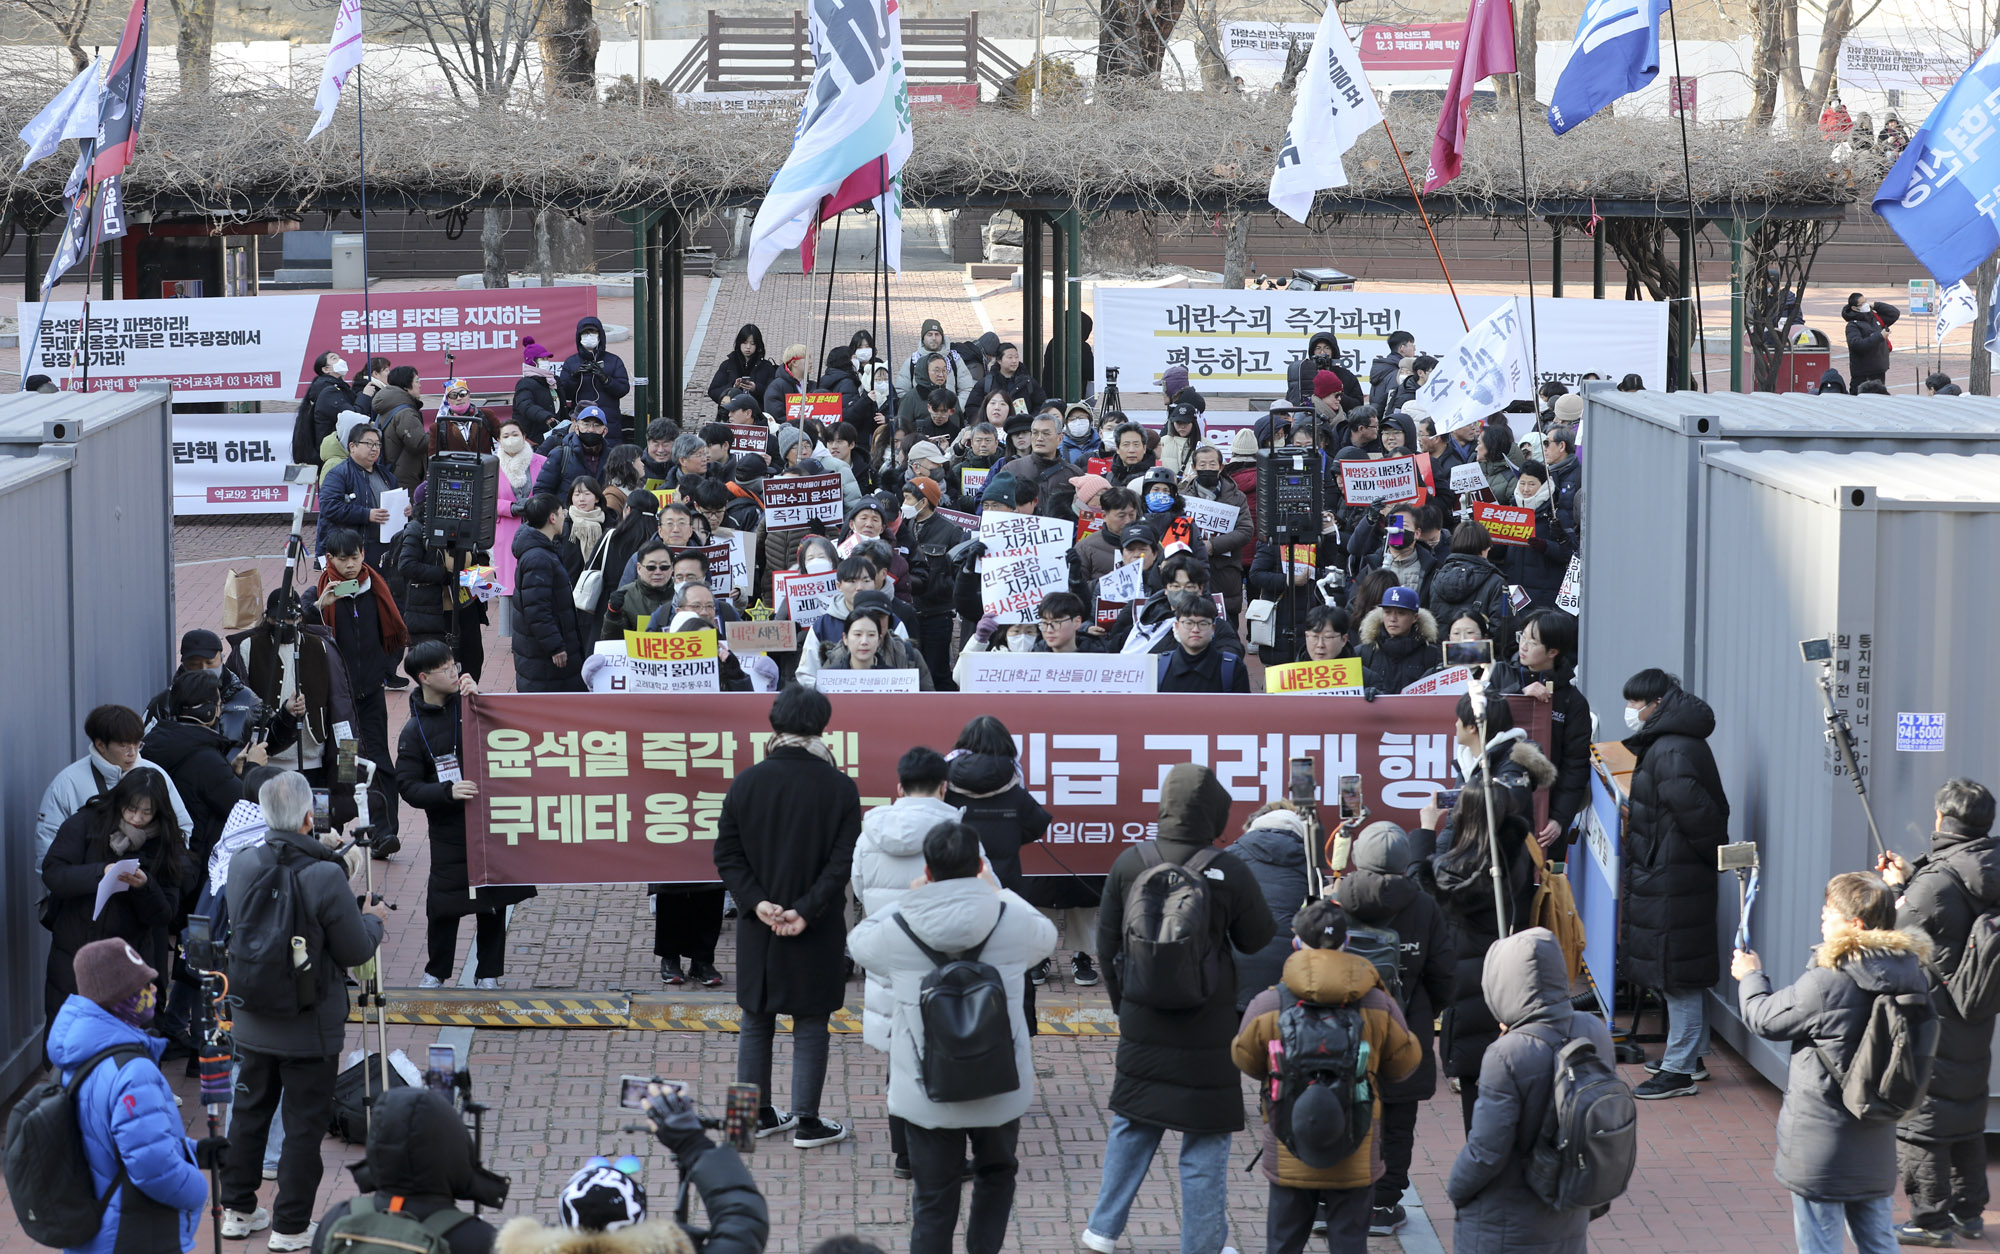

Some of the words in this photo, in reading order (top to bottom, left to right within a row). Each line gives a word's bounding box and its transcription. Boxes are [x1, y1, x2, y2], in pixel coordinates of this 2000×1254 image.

[1231, 38, 1256, 49] 반민주
[1269, 28, 1317, 40] 민주광장에
[1376, 40, 1394, 51] 12.3
[40, 319, 83, 335] 윤석열
[88, 318, 119, 334] 즉각
[123, 316, 189, 331] 파면하라!
[340, 308, 397, 330] 윤석열
[402, 307, 460, 328] 퇴진을
[464, 305, 541, 326] 지지하는
[1165, 304, 1272, 335] 내란수괴
[1284, 307, 1402, 337] 즉각파면!
[40, 335, 86, 352] 쿠데타
[89, 333, 164, 351] 옹호자들은
[169, 330, 262, 349] 민주광장에서
[340, 332, 417, 354] 후배들을
[422, 329, 518, 352] 응원합니다
[41, 352, 72, 368] 당장
[75, 351, 126, 368] 나가라!
[92, 379, 125, 392] 사범대
[227, 376, 240, 387] 03
[243, 375, 274, 387] 나지현
[172, 441, 218, 464] 탄핵
[224, 440, 276, 463] 하라.
[739, 439, 766, 450] 윤석열
[1378, 462, 1413, 477] 내란동조
[766, 492, 808, 506] 내란수괴
[811, 487, 841, 502] 윤석열
[773, 508, 801, 523] 즉각
[805, 504, 838, 520] 파면!
[1481, 507, 1528, 523] 윤석열을
[981, 516, 1041, 539] 민주광장
[1478, 519, 1534, 540] 파면하라!
[1003, 527, 1065, 550] 지켜내고
[708, 560, 729, 573] 석열
[982, 557, 1041, 588] 민주광장
[789, 581, 827, 598] 계엄옹호
[1005, 566, 1063, 596] 지켜내고
[636, 636, 704, 660] 내란옹호
[671, 661, 716, 677] 물러가라
[975, 668, 1041, 683] 고려대학교
[1045, 668, 1098, 683] 학생들이
[1101, 668, 1145, 684] 말한다!
[1279, 664, 1349, 691] 내란옹호
[671, 680, 712, 692] 민주동우회
[1899, 725, 1943, 739] 941-5000
[486, 727, 630, 779] 윤석열
[641, 730, 738, 780] 즉각
[1141, 732, 1358, 807] 고려대
[1378, 731, 1458, 810] 행
[488, 792, 632, 847] 쿠데타
[1034, 822, 1115, 844] 1일(금)
